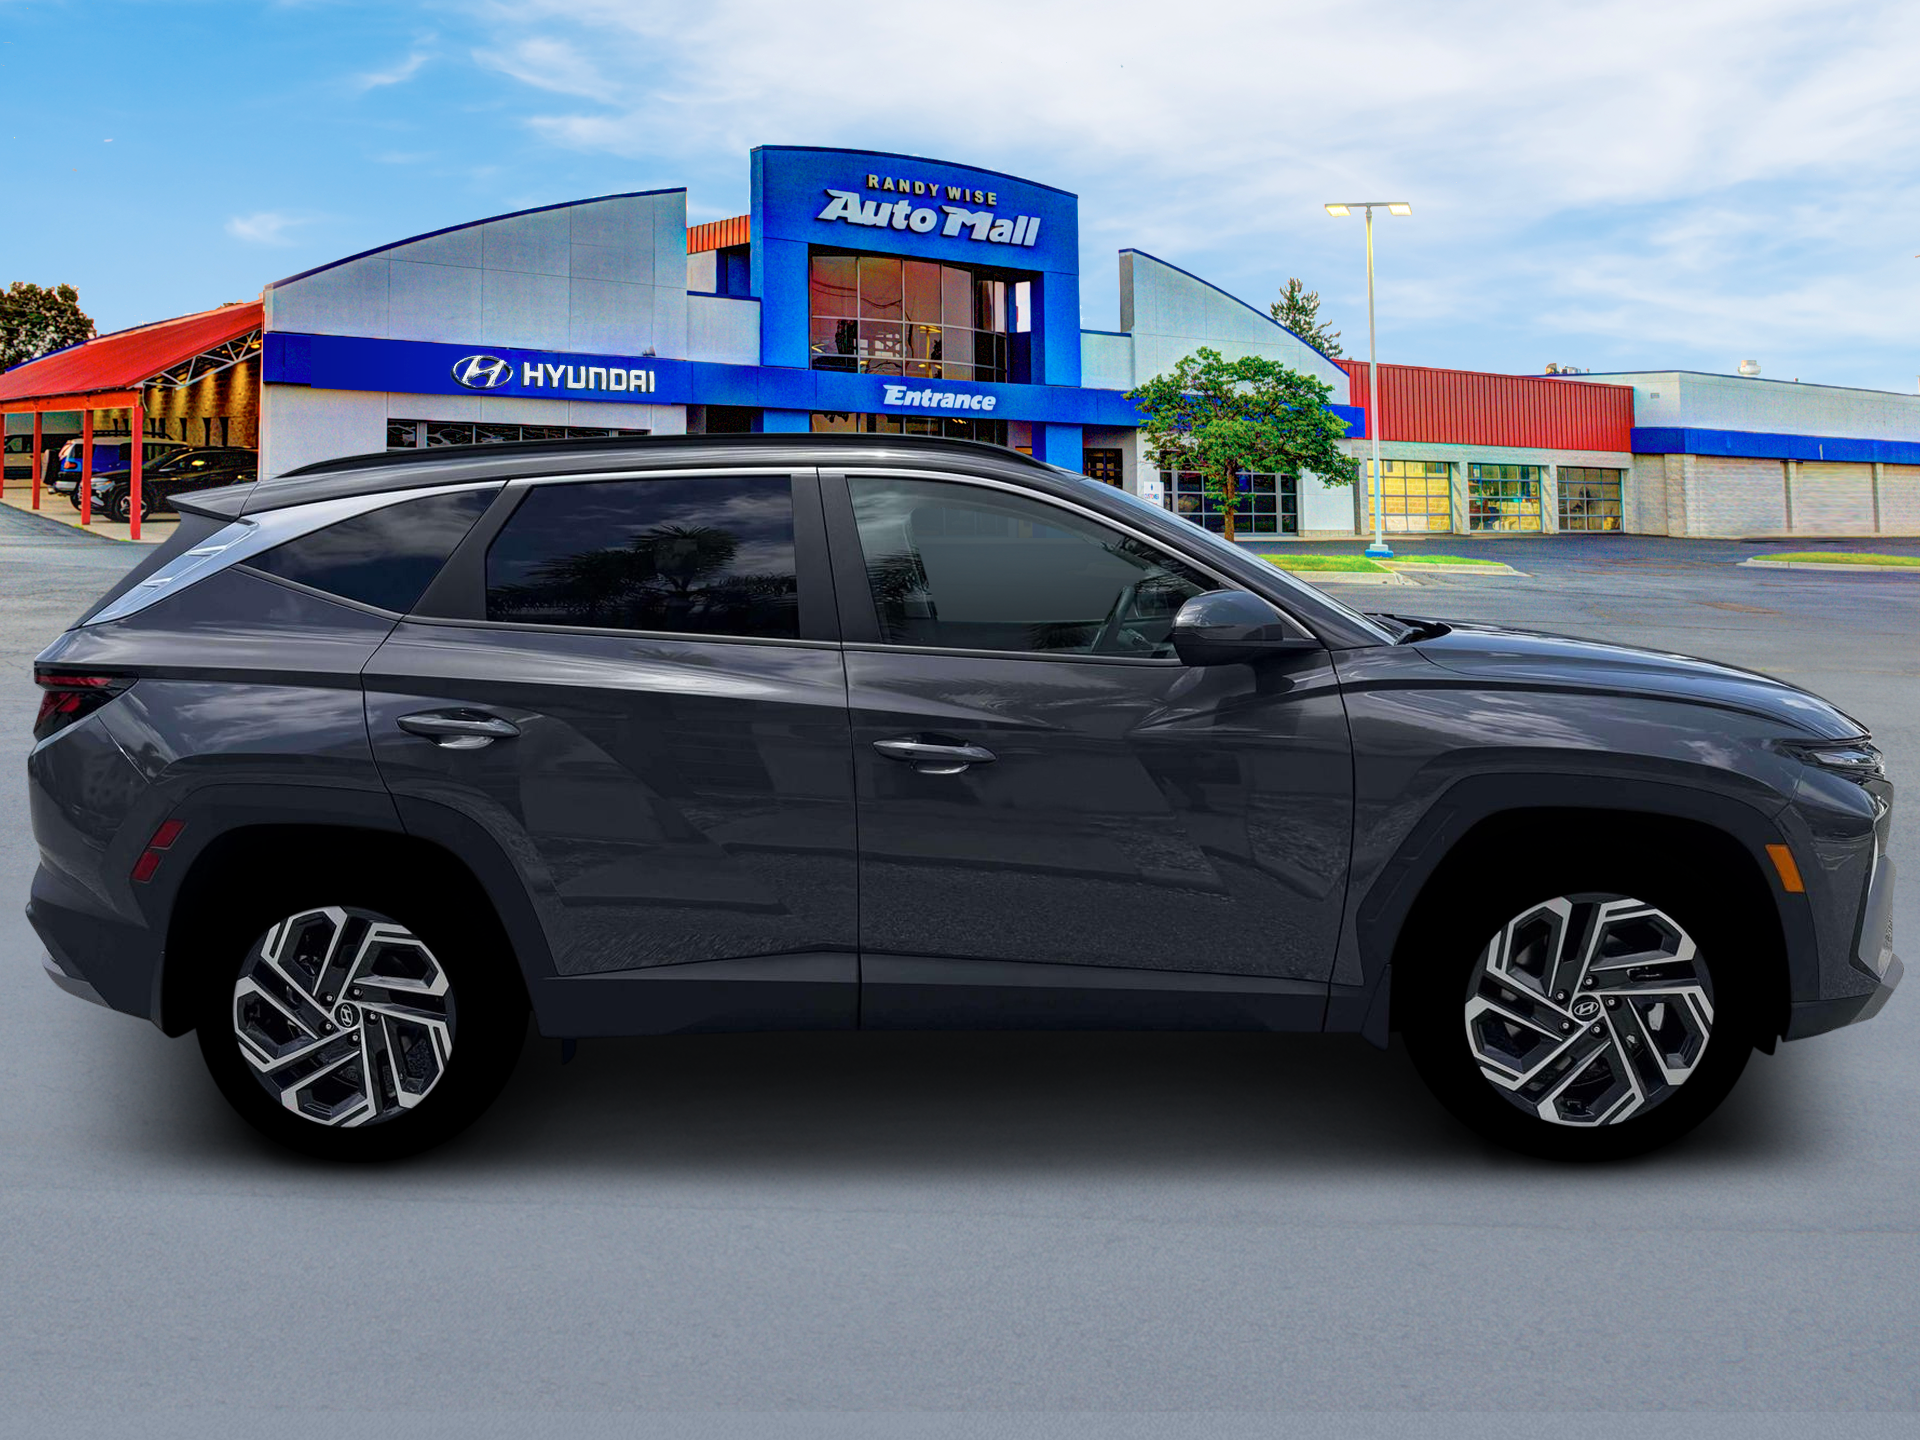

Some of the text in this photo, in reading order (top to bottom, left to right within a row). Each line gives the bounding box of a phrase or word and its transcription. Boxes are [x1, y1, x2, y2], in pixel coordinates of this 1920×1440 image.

[867, 173, 998, 206] RANDY WISE
[816, 188, 1041, 247] Auto Mall
[522, 362, 655, 392] HYUNDAI
[882, 384, 997, 411] Entrance
